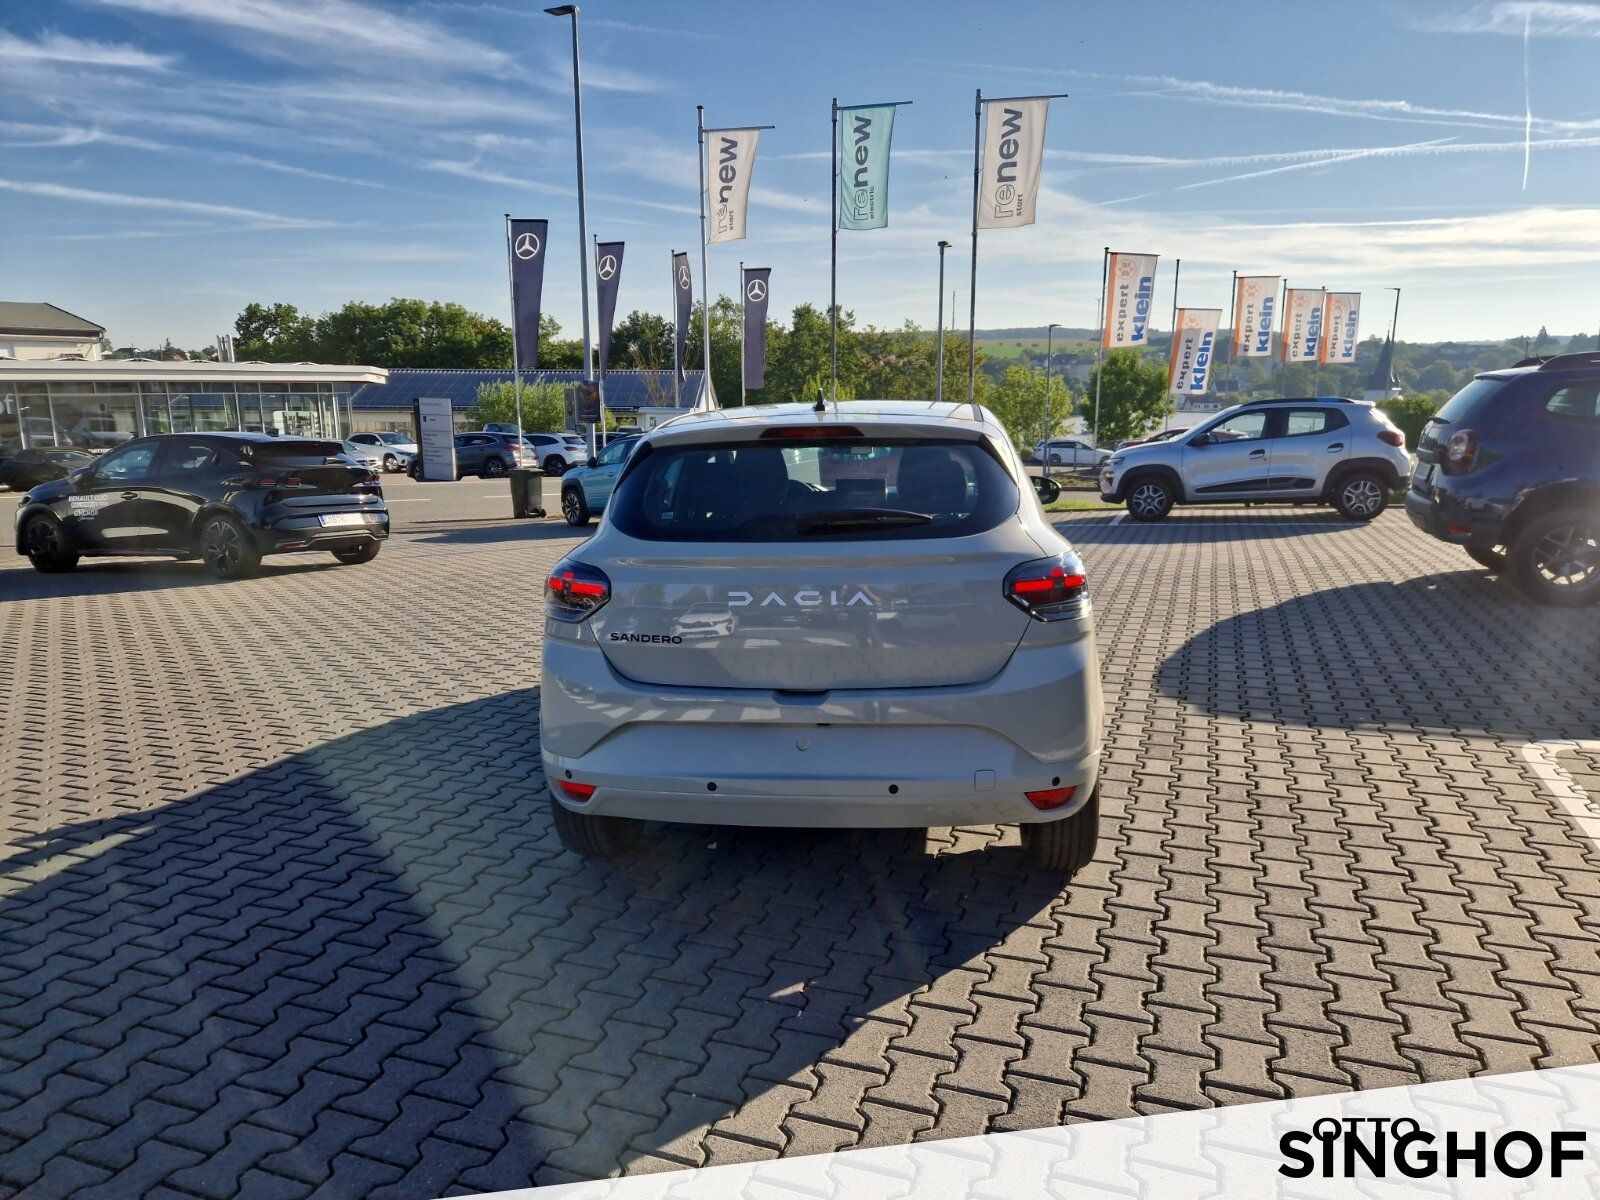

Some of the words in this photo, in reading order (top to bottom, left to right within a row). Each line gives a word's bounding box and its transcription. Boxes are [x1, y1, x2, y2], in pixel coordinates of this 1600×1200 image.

[717, 136, 739, 234] renew
[853, 115, 872, 221] renew
[993, 107, 1023, 219] renew
[1015, 193, 1024, 217] start
[1116, 283, 1130, 342] expert
[1131, 276, 1152, 342] klein
[1243, 303, 1254, 352] expert
[1256, 296, 1274, 352] klein
[1304, 307, 1321, 357] klein
[1342, 310, 1357, 358] klein
[1291, 312, 1302, 358] expert
[1330, 315, 1341, 358] expert
[1176, 337, 1194, 390] expert
[1190, 331, 1213, 391] klein
[728, 591, 874, 607] DACIA
[610, 632, 682, 645] SANDERO
